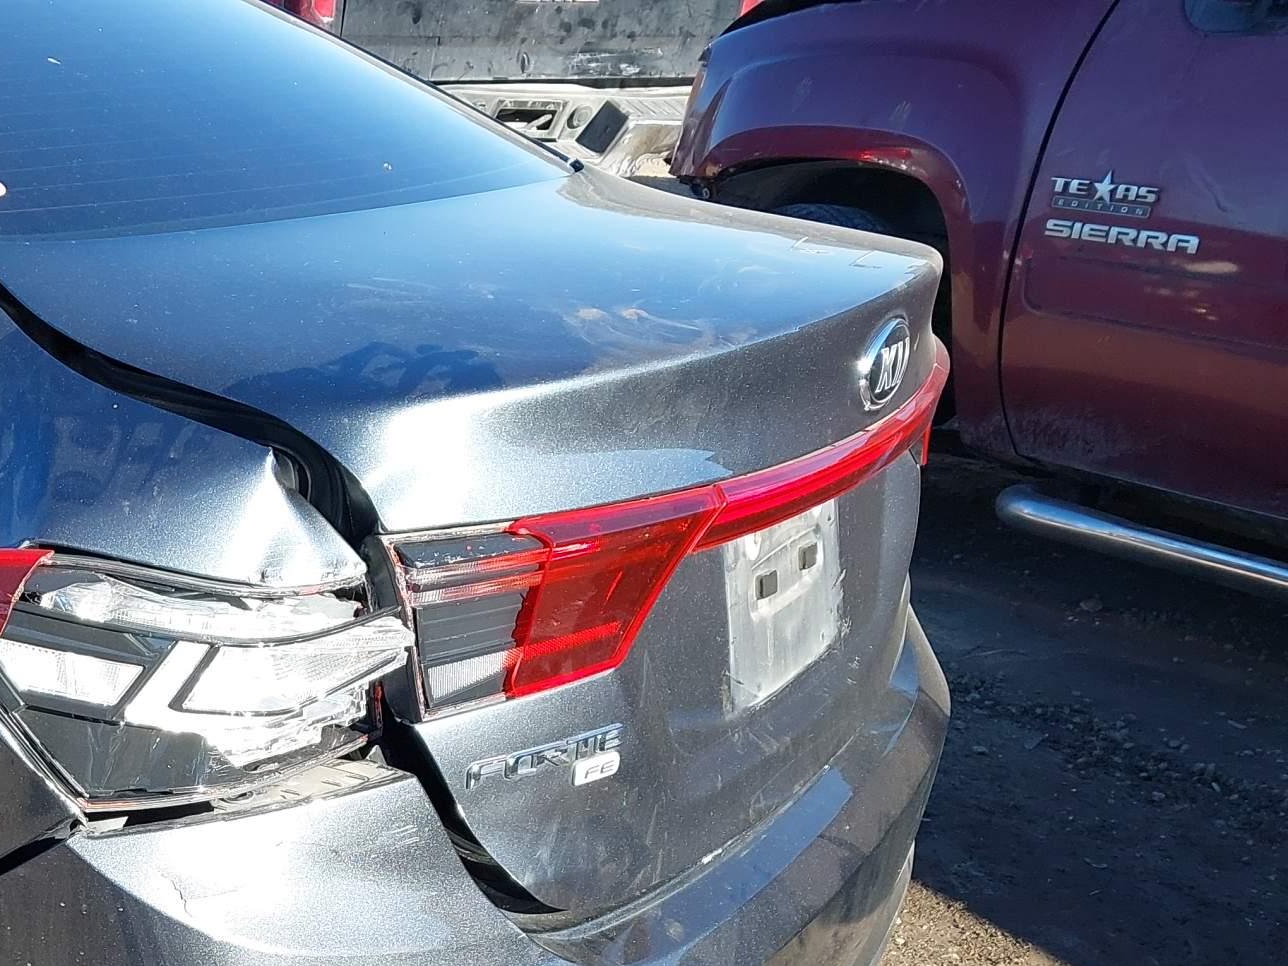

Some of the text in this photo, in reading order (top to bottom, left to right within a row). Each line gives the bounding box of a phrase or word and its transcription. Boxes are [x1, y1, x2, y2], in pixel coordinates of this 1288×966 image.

[1051, 171, 1160, 203] TEXAS
[1057, 200, 1144, 215] EDITION
[1044, 219, 1200, 255] SIERRA
[465, 722, 624, 790] FORTE
